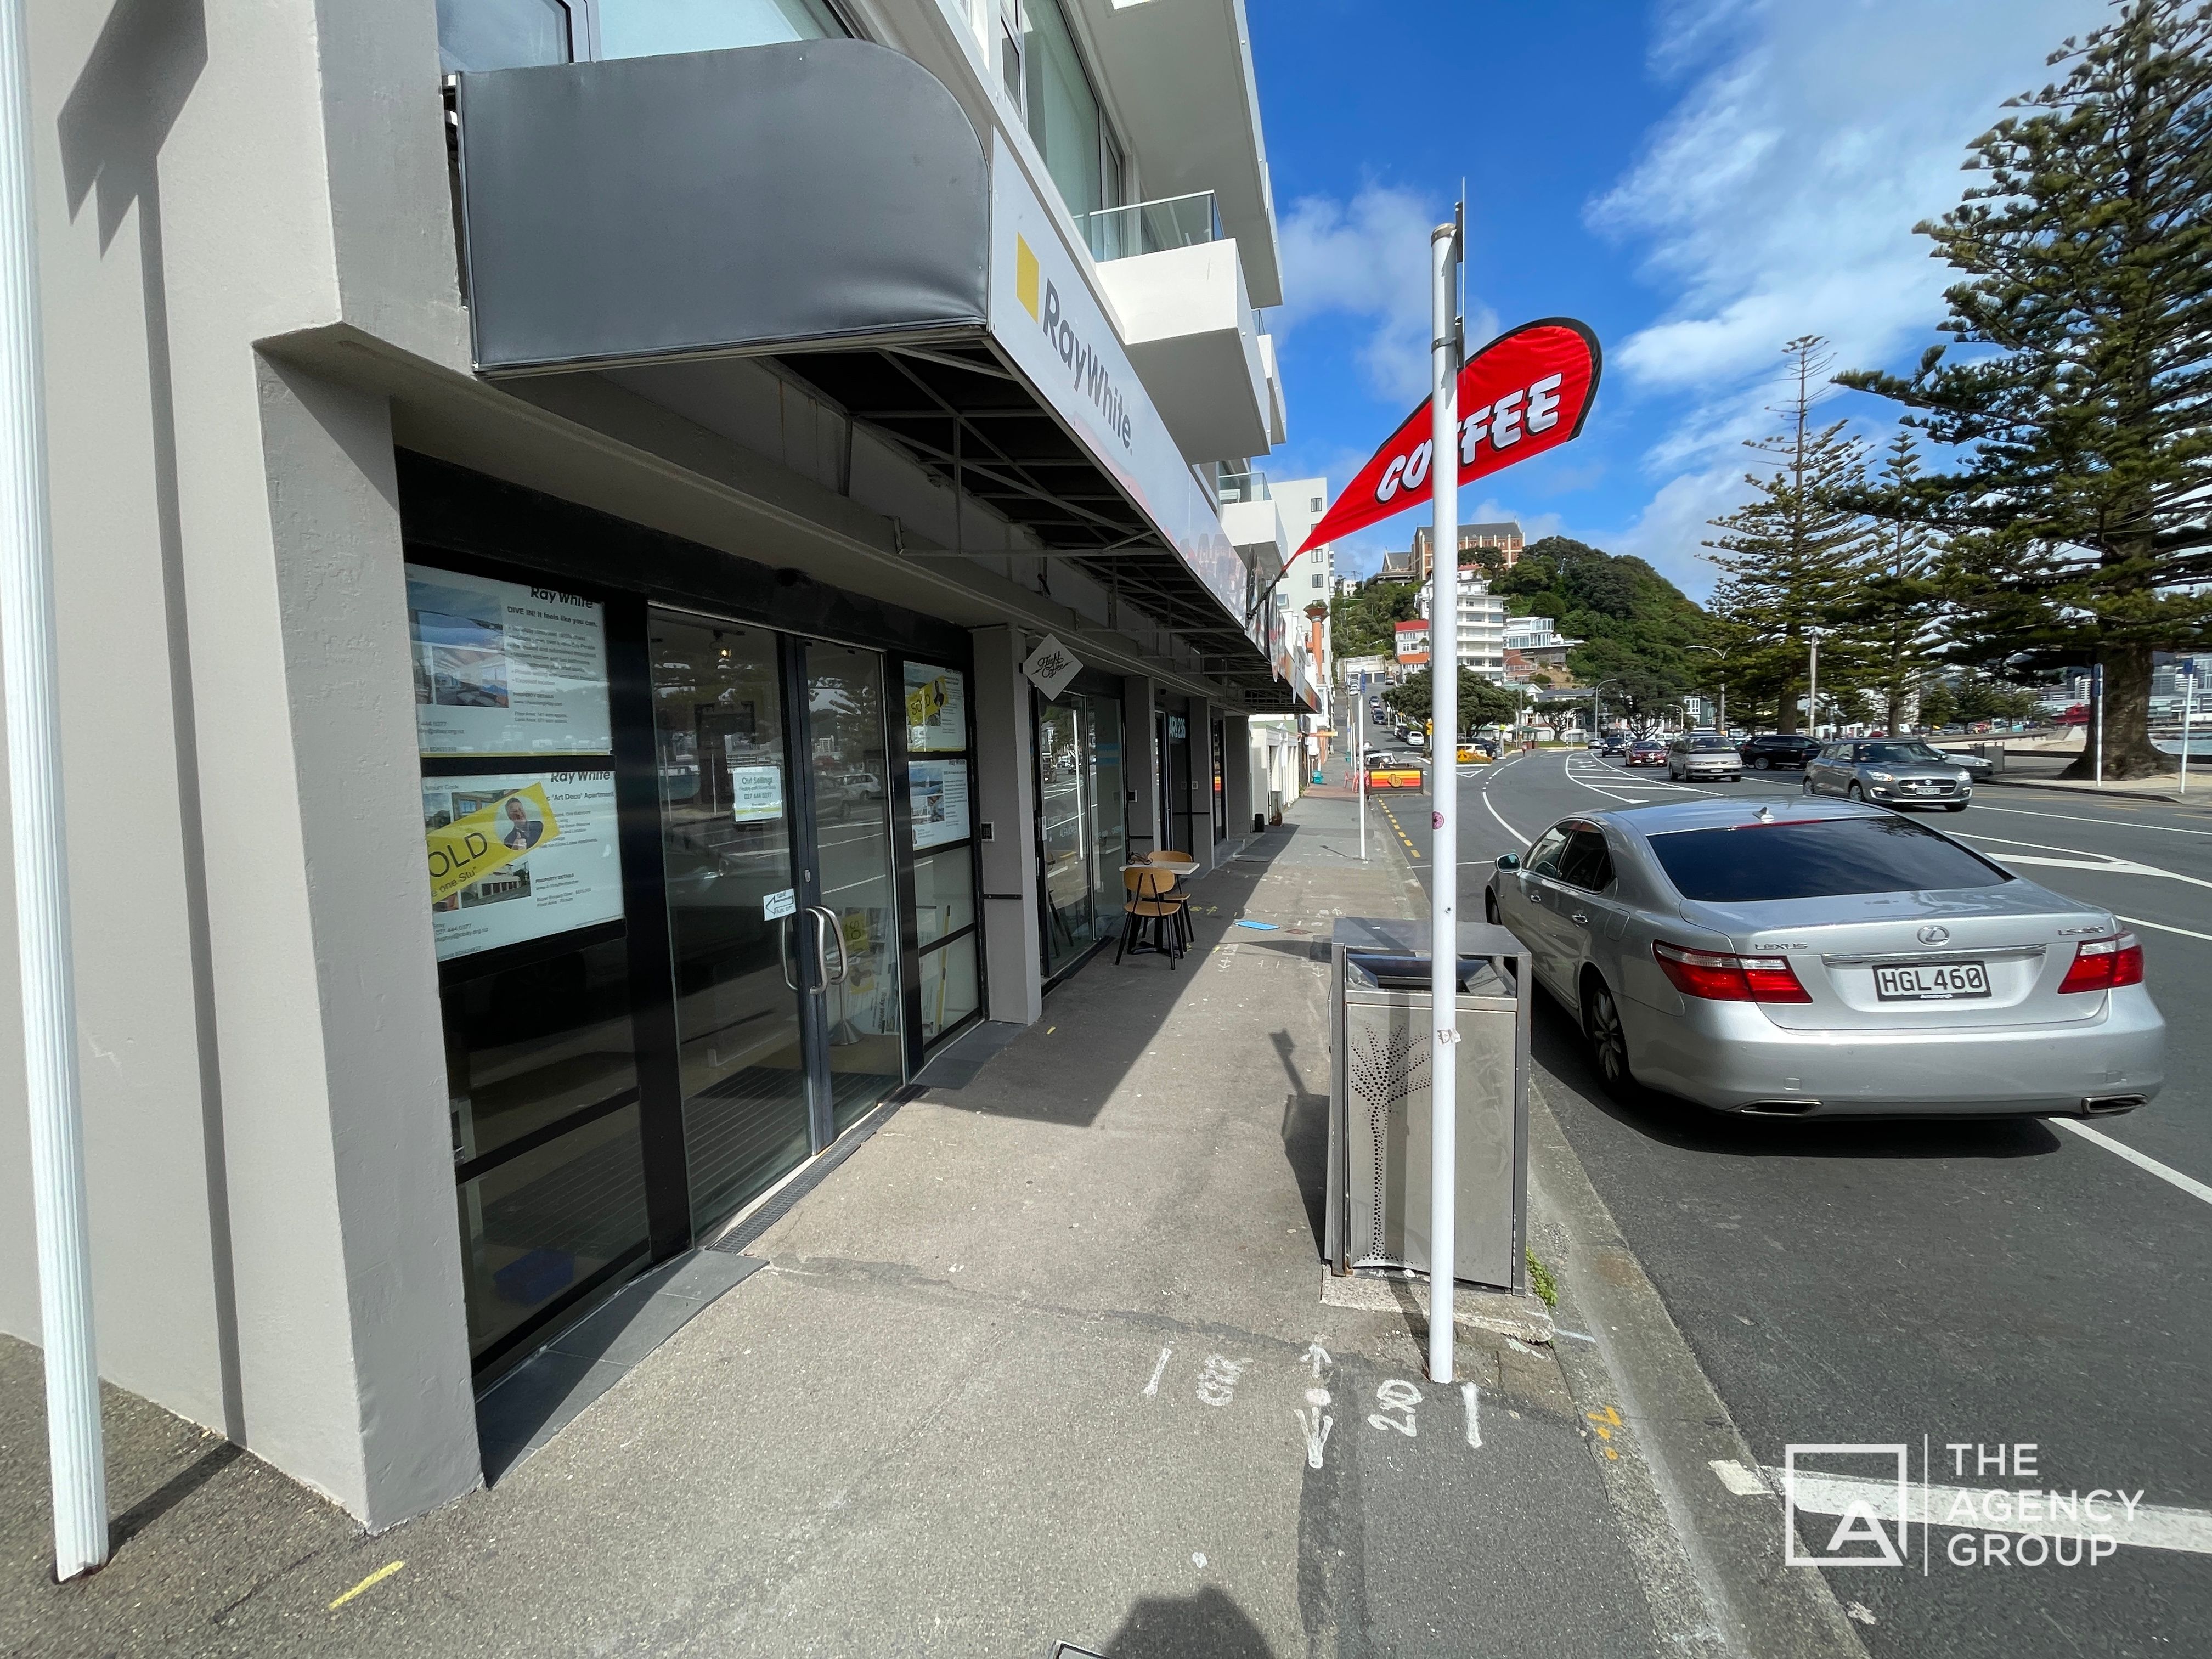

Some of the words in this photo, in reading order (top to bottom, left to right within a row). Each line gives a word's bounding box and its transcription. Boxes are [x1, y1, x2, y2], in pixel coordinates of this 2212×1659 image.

[1375, 373, 1563, 503] COFEE
[531, 588, 556, 603] Ray
[507, 606, 524, 615] DIVE
[544, 612, 559, 620] feels
[1042, 664, 1064, 679] Coffee
[551, 772, 575, 785] Ray
[428, 832, 488, 877] OLD
[1754, 942, 1808, 950] LEXUS
[1881, 967, 1983, 992] HGL460
